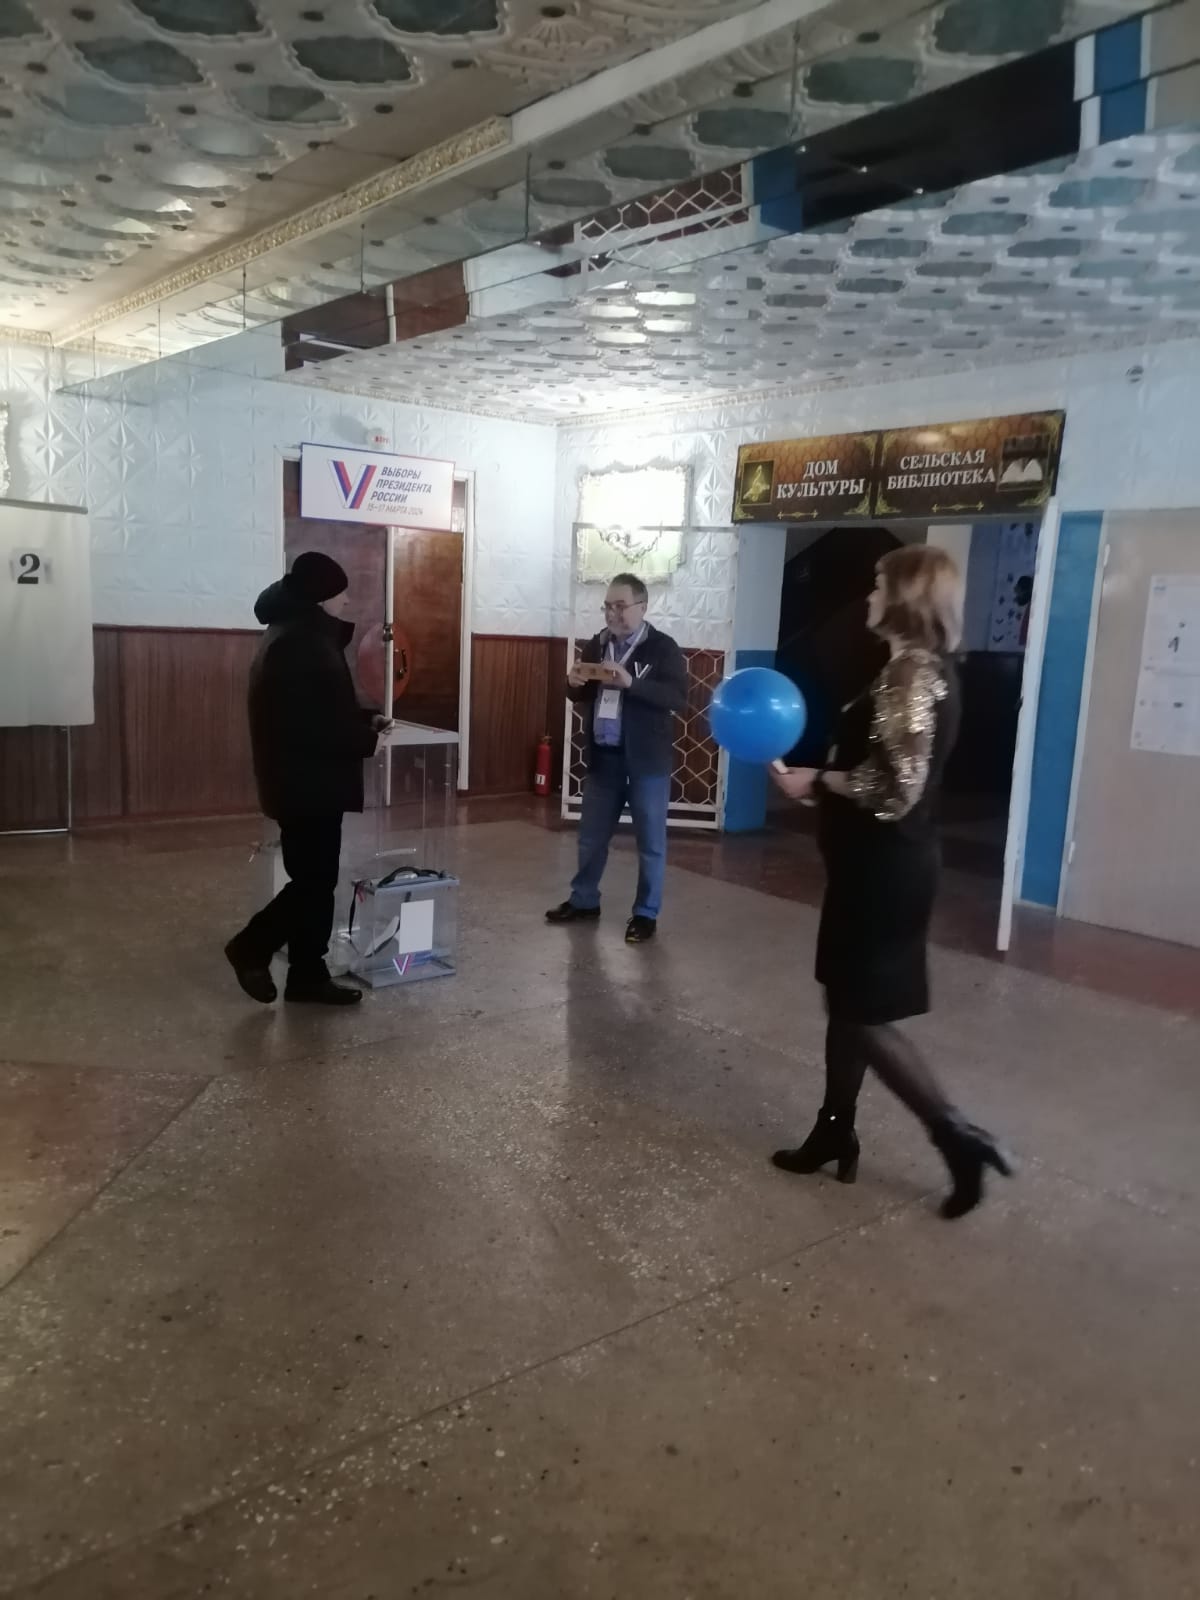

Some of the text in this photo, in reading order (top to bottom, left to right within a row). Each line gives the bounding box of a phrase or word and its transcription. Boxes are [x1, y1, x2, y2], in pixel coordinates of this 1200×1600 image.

[900, 449, 986, 470] СЕЛЬСКАЯ
[381, 466, 422, 480] ВЫБОРЫ
[803, 460, 839, 480] ДОМ
[887, 467, 996, 490] БИБЛИОТЕКА
[376, 479, 432, 493] ПРЕЗИДЕНТА
[777, 478, 866, 499] КУЛЬТУРЫ
[370, 491, 408, 503] РОССИИ
[17, 553, 40, 585] 2
